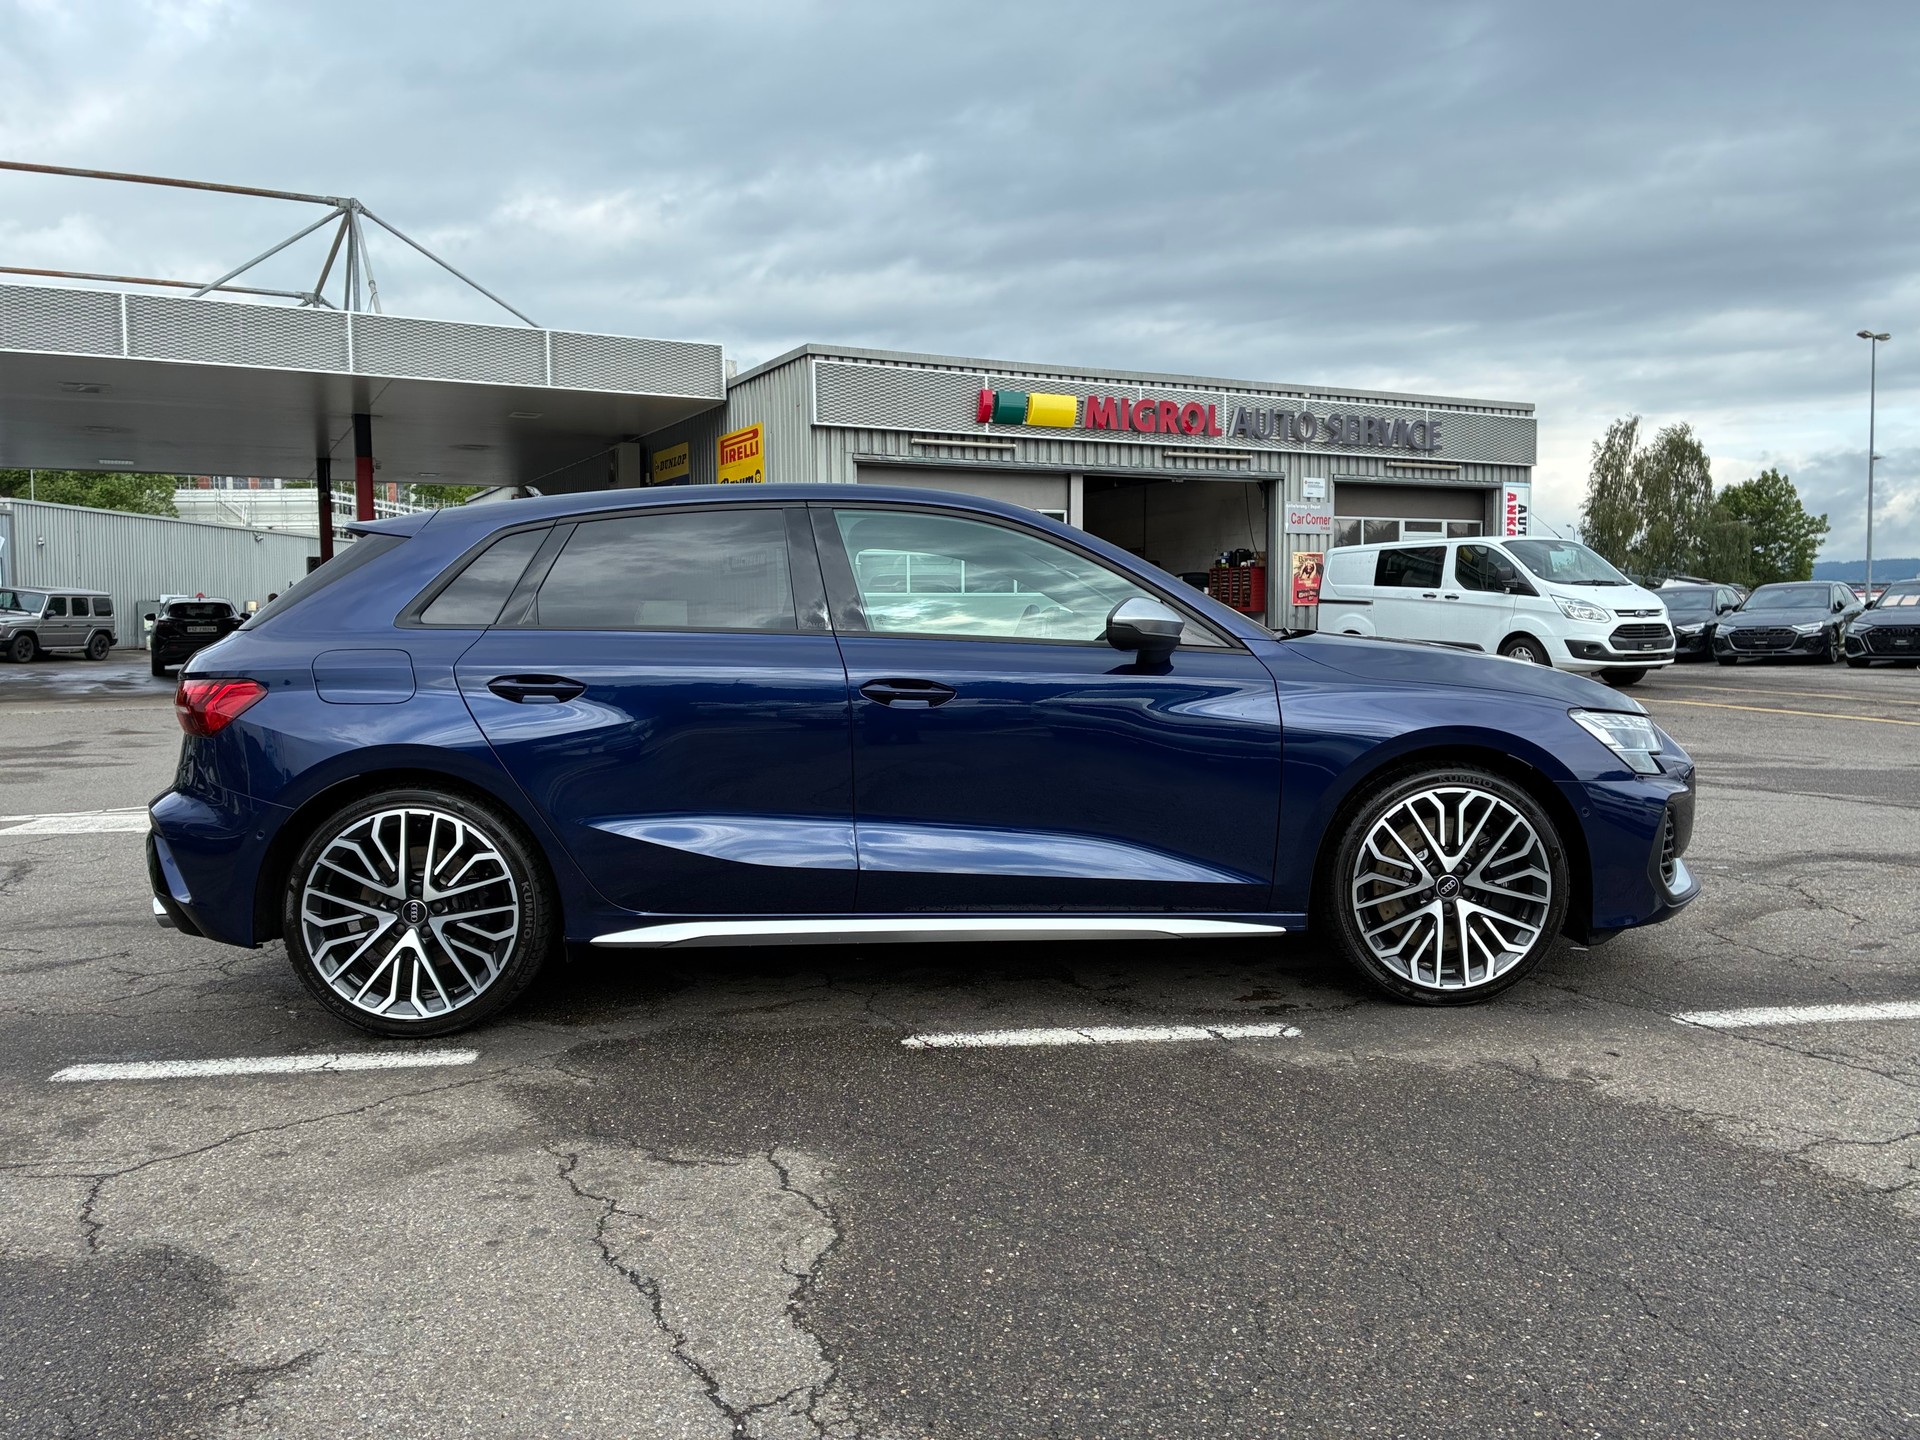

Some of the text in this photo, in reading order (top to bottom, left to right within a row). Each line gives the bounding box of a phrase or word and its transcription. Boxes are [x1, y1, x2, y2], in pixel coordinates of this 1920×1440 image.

[1083, 395, 1443, 450] MIGROL AUTO SERVICE
[660, 453, 687, 471] DUNLOP
[720, 427, 759, 465] PIRELLI
[1291, 512, 1331, 525] Car Corner
[1507, 492, 1517, 536] ANKA
[1438, 774, 1493, 787] KUMHO
[521, 881, 534, 940] KUMHO
